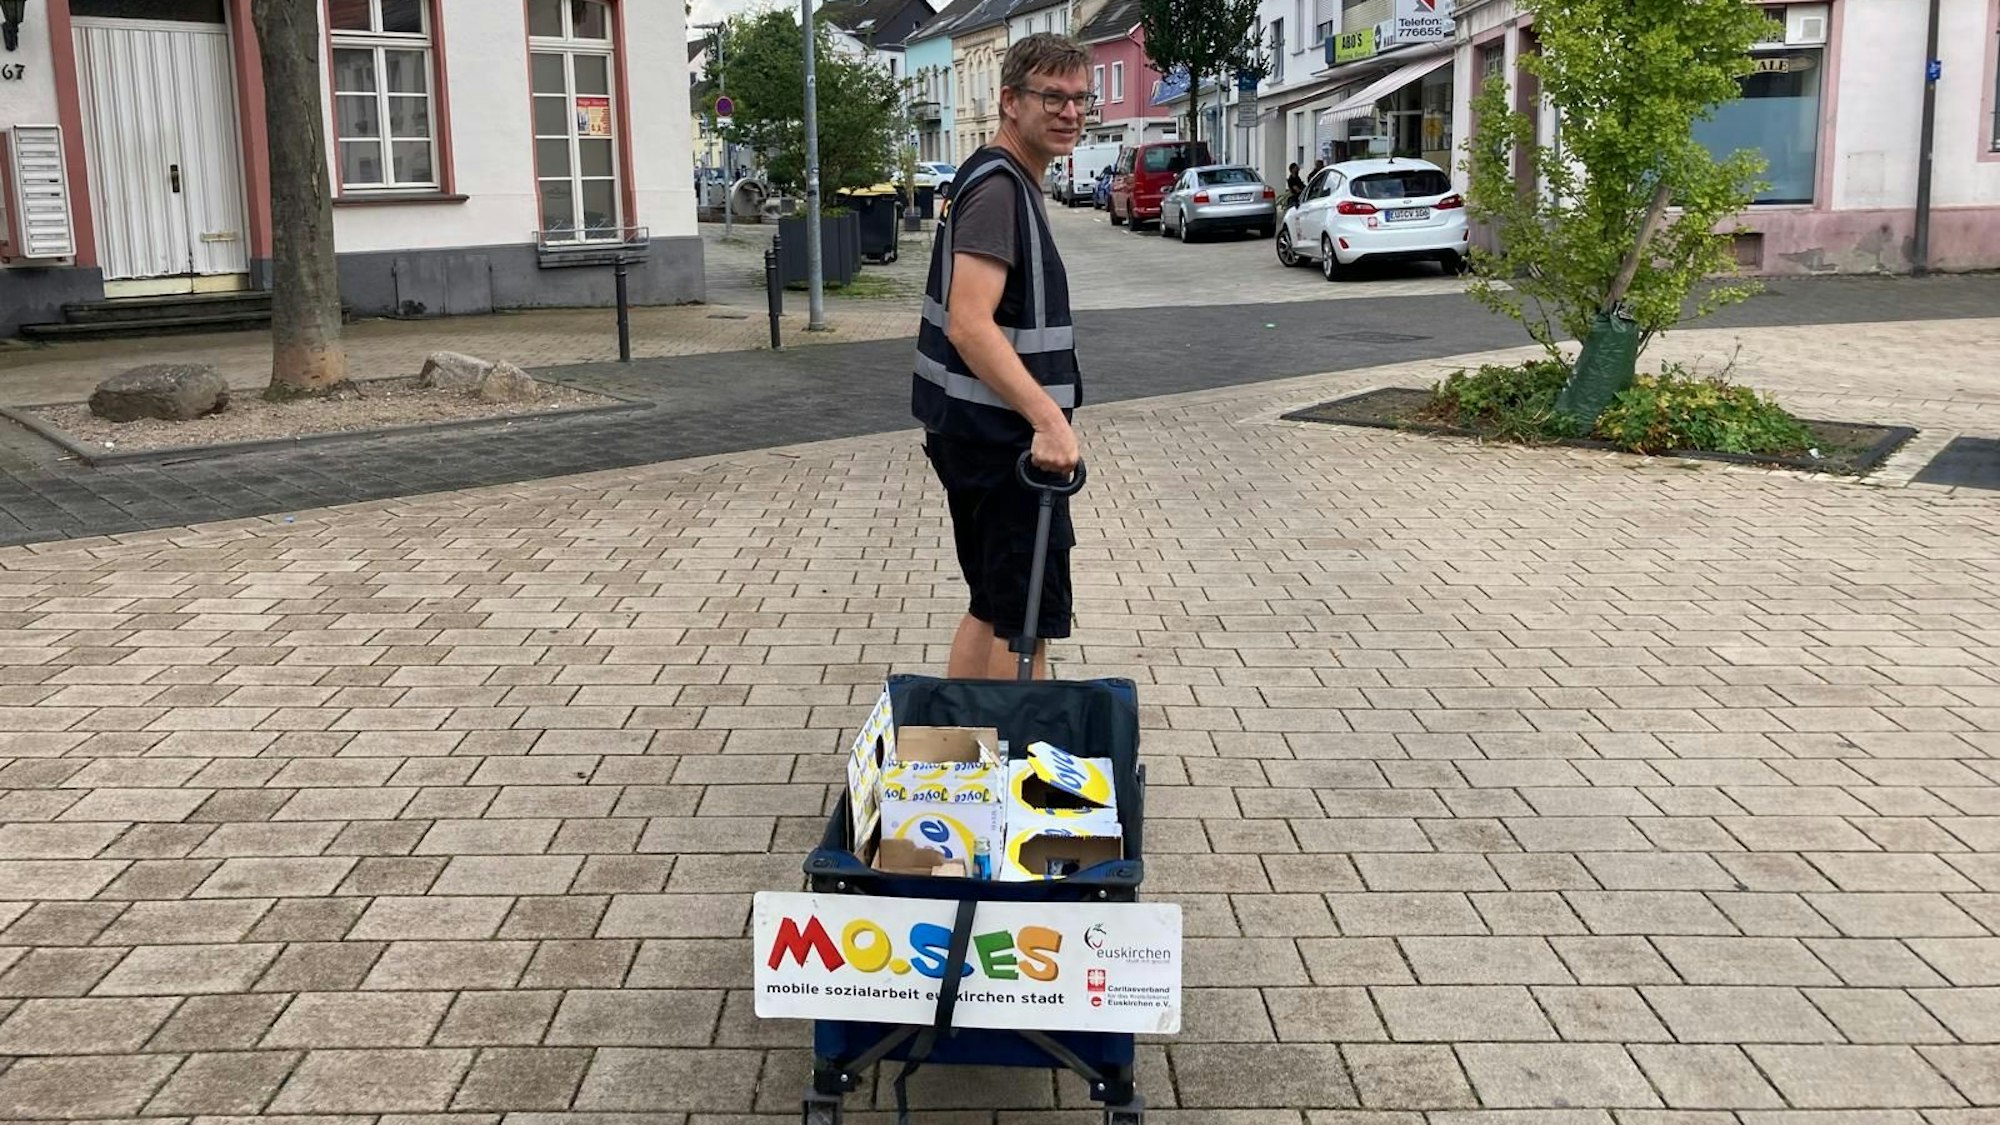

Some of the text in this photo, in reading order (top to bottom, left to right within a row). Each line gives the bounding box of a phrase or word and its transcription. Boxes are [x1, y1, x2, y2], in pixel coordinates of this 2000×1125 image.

[1399, 18, 1442, 28] Telefon:
[1398, 27, 1443, 38] 776655
[2, 63, 26, 80] 67
[1757, 60, 1788, 72] ALE
[912, 787, 949, 802] Joyce
[954, 787, 991, 802] Joyce
[1096, 946, 1172, 959] euskirchen
[766, 983, 820, 996] mobile
[824, 984, 920, 1000] sozialarbeit
[1020, 991, 1065, 1005] stadt
[1107, 985, 1170, 994] Caritasverband
